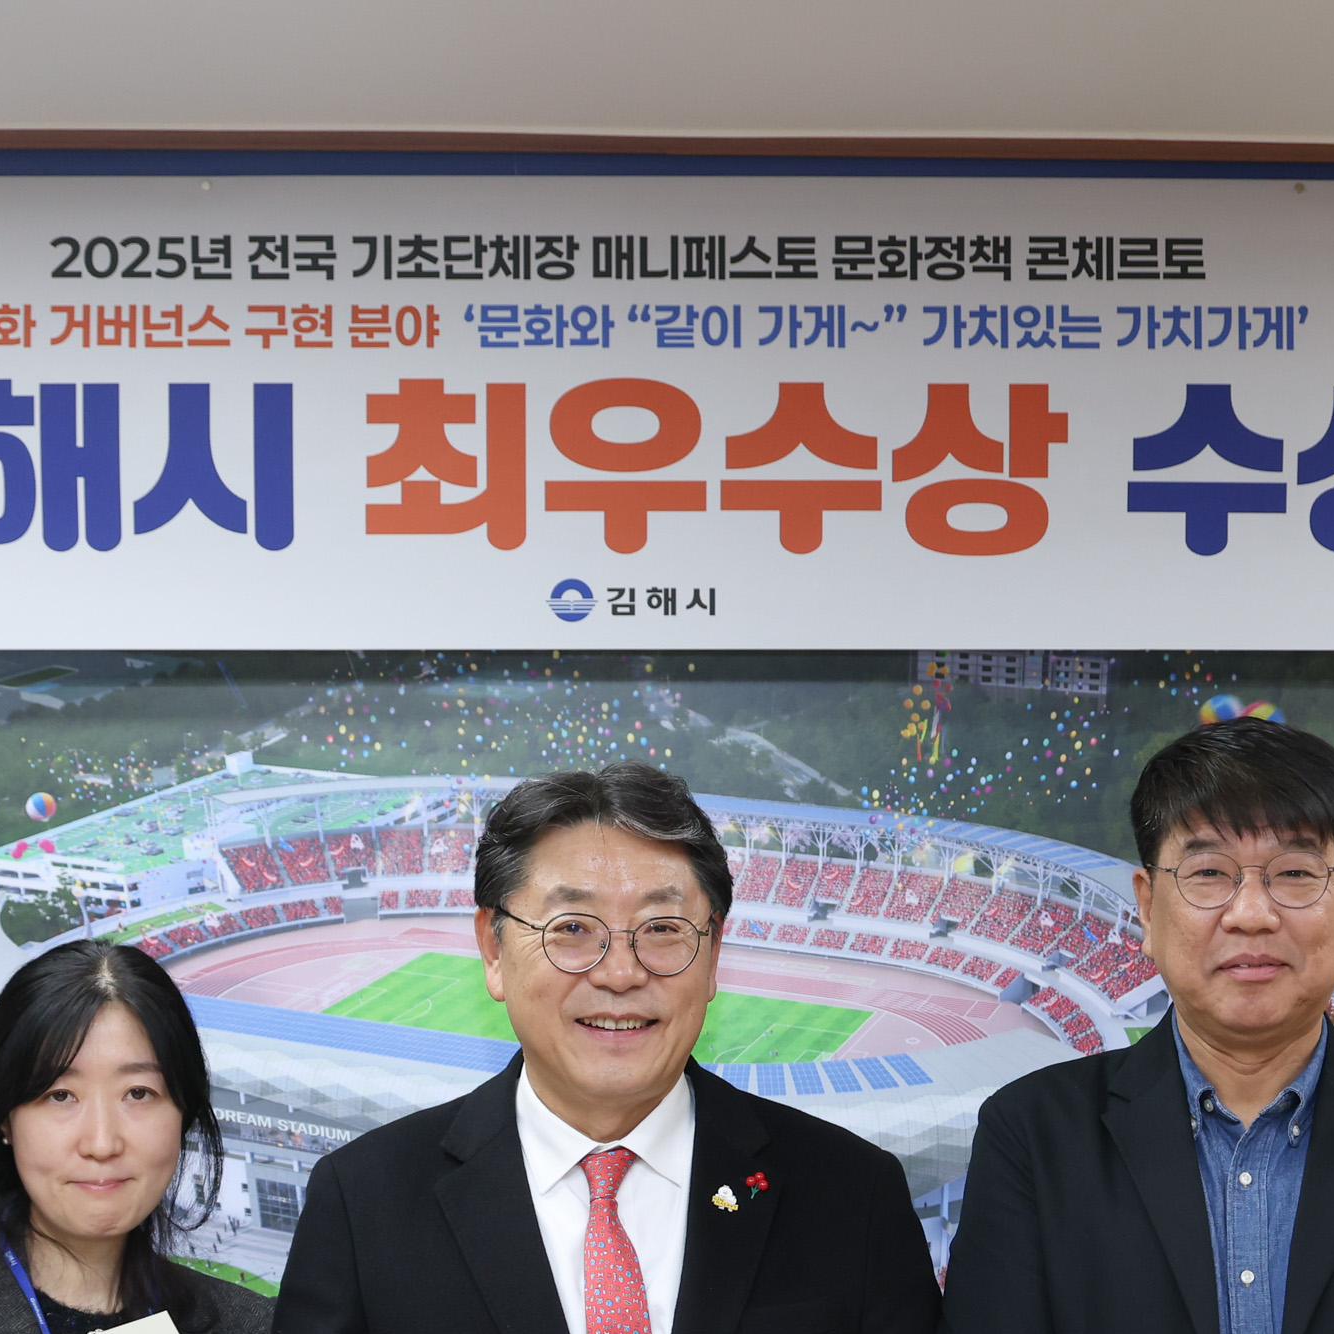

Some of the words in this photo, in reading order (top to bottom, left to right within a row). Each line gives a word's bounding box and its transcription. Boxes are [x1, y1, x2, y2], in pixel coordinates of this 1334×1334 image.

[49, 234, 234, 281] 2025년
[246, 234, 337, 281] 전국
[350, 234, 581, 282] 기초단체장
[592, 235, 818, 282] 매니페스토
[830, 235, 1014, 282] 문화정책
[1024, 235, 1207, 282] 콘체르토
[49, 302, 232, 350] 거버넌스
[244, 302, 335, 350] 구현
[347, 303, 440, 350] 분야
[463, 303, 615, 350] ‘문화와
[627, 303, 742, 350] “같이
[922, 303, 1103, 351] 가치있는
[1116, 305, 1311, 352] 가치가게’
[363, 376, 1069, 557] 최우수상
[606, 586, 717, 617] 김해시
[213, 1108, 272, 1128] DREAM
[277, 1120, 352, 1142] STADIUM
